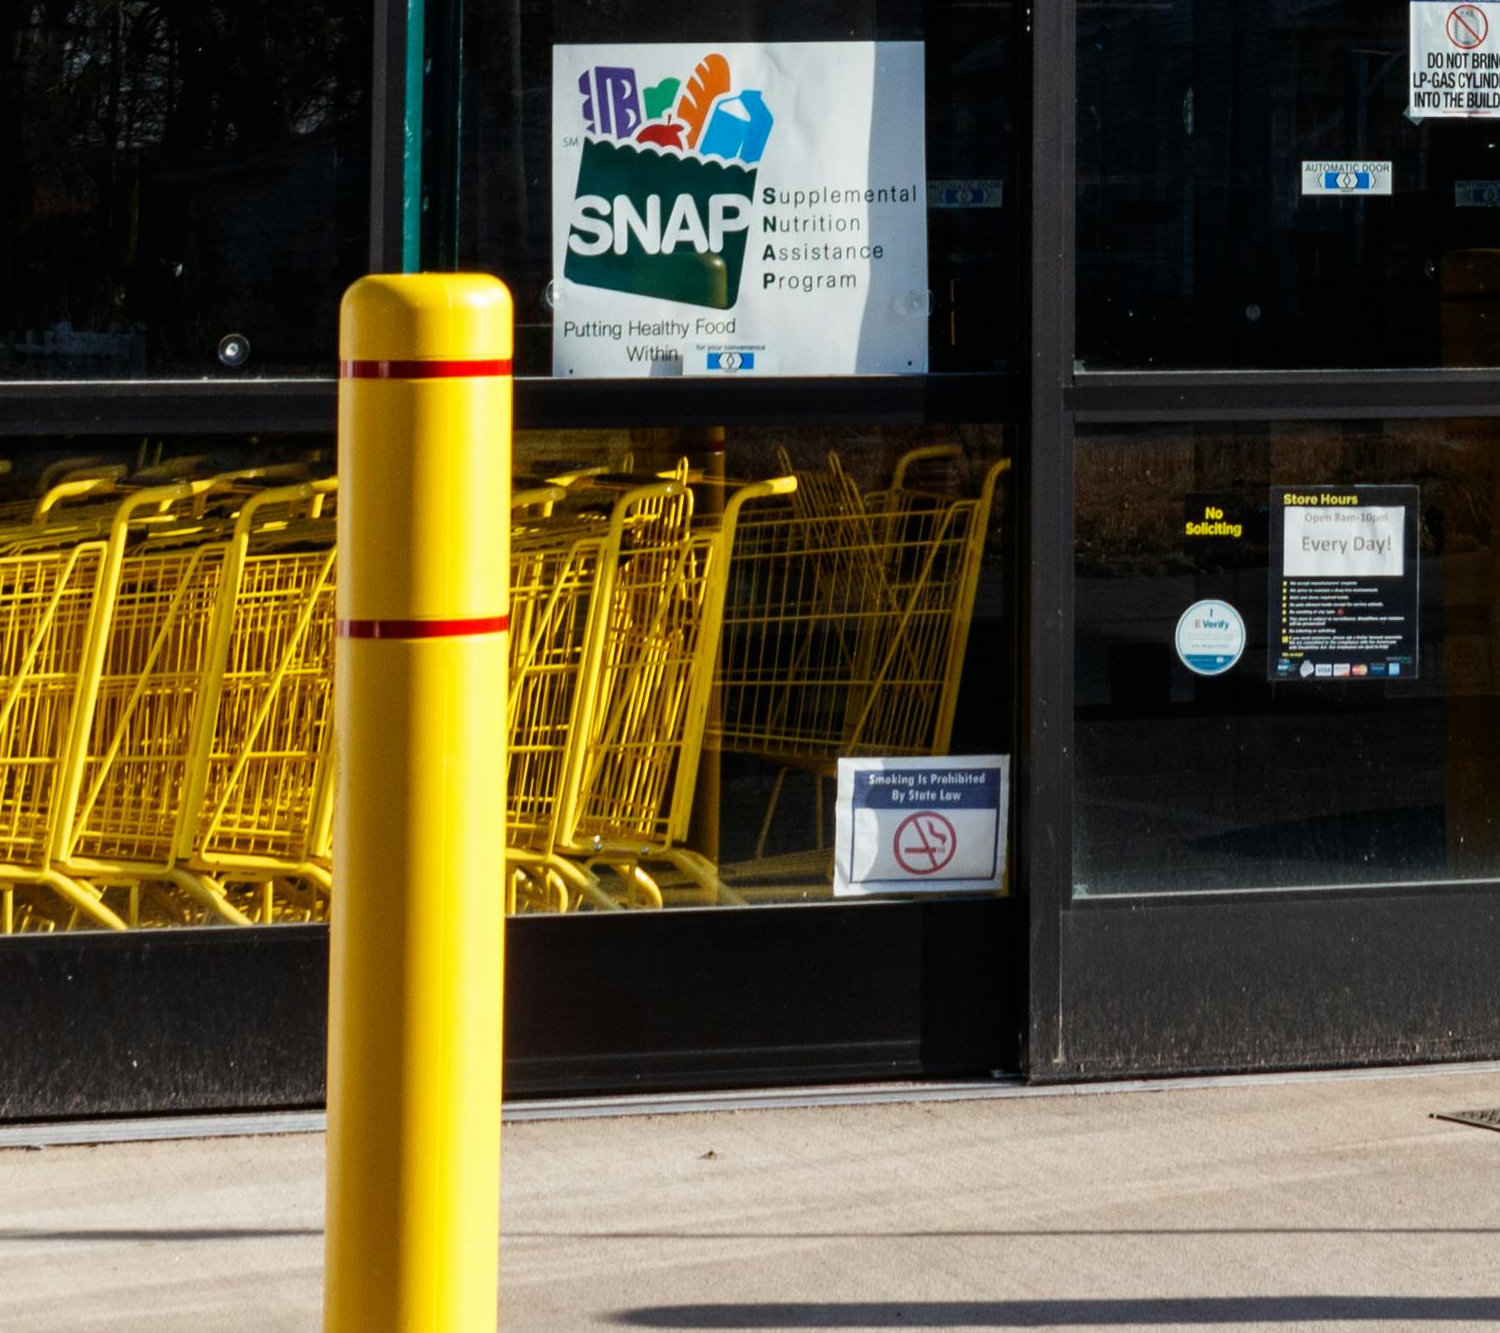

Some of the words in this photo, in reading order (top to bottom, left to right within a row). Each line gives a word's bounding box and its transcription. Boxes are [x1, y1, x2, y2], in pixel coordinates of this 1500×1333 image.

[1427, 53, 1444, 69] DO
[1446, 53, 1470, 69] NOT
[1413, 72, 1456, 89] LP-GAS
[1414, 91, 1441, 108] INTO
[1443, 92, 1464, 108] THE
[1305, 163, 1360, 173] AUTOMATIC
[1362, 163, 1390, 173] DOOR
[763, 184, 917, 208] Supplemental
[568, 193, 751, 257] SNAP
[763, 214, 861, 233] Nutrition
[763, 244, 884, 261] Assistance
[763, 273, 857, 293] Program
[564, 321, 622, 340] Putting
[628, 319, 690, 339] Healthy
[695, 318, 736, 334] Food
[626, 345, 679, 362] Within
[1283, 493, 1319, 505] Store
[1320, 493, 1359, 505] Hours
[1205, 507, 1224, 521] No
[1304, 513, 1332, 524] Open
[1334, 512, 1389, 524] 8am-10pm
[1185, 522, 1243, 538] Soliciting
[1301, 536, 1348, 554] Every
[1353, 536, 1392, 554] Day!
[1202, 619, 1230, 632] Verify
[868, 774, 915, 787] Smoking
[918, 774, 928, 785] Is
[930, 773, 986, 785] Prohibited
[891, 789, 906, 804] By
[908, 789, 937, 802] State
[940, 789, 962, 801] Law
